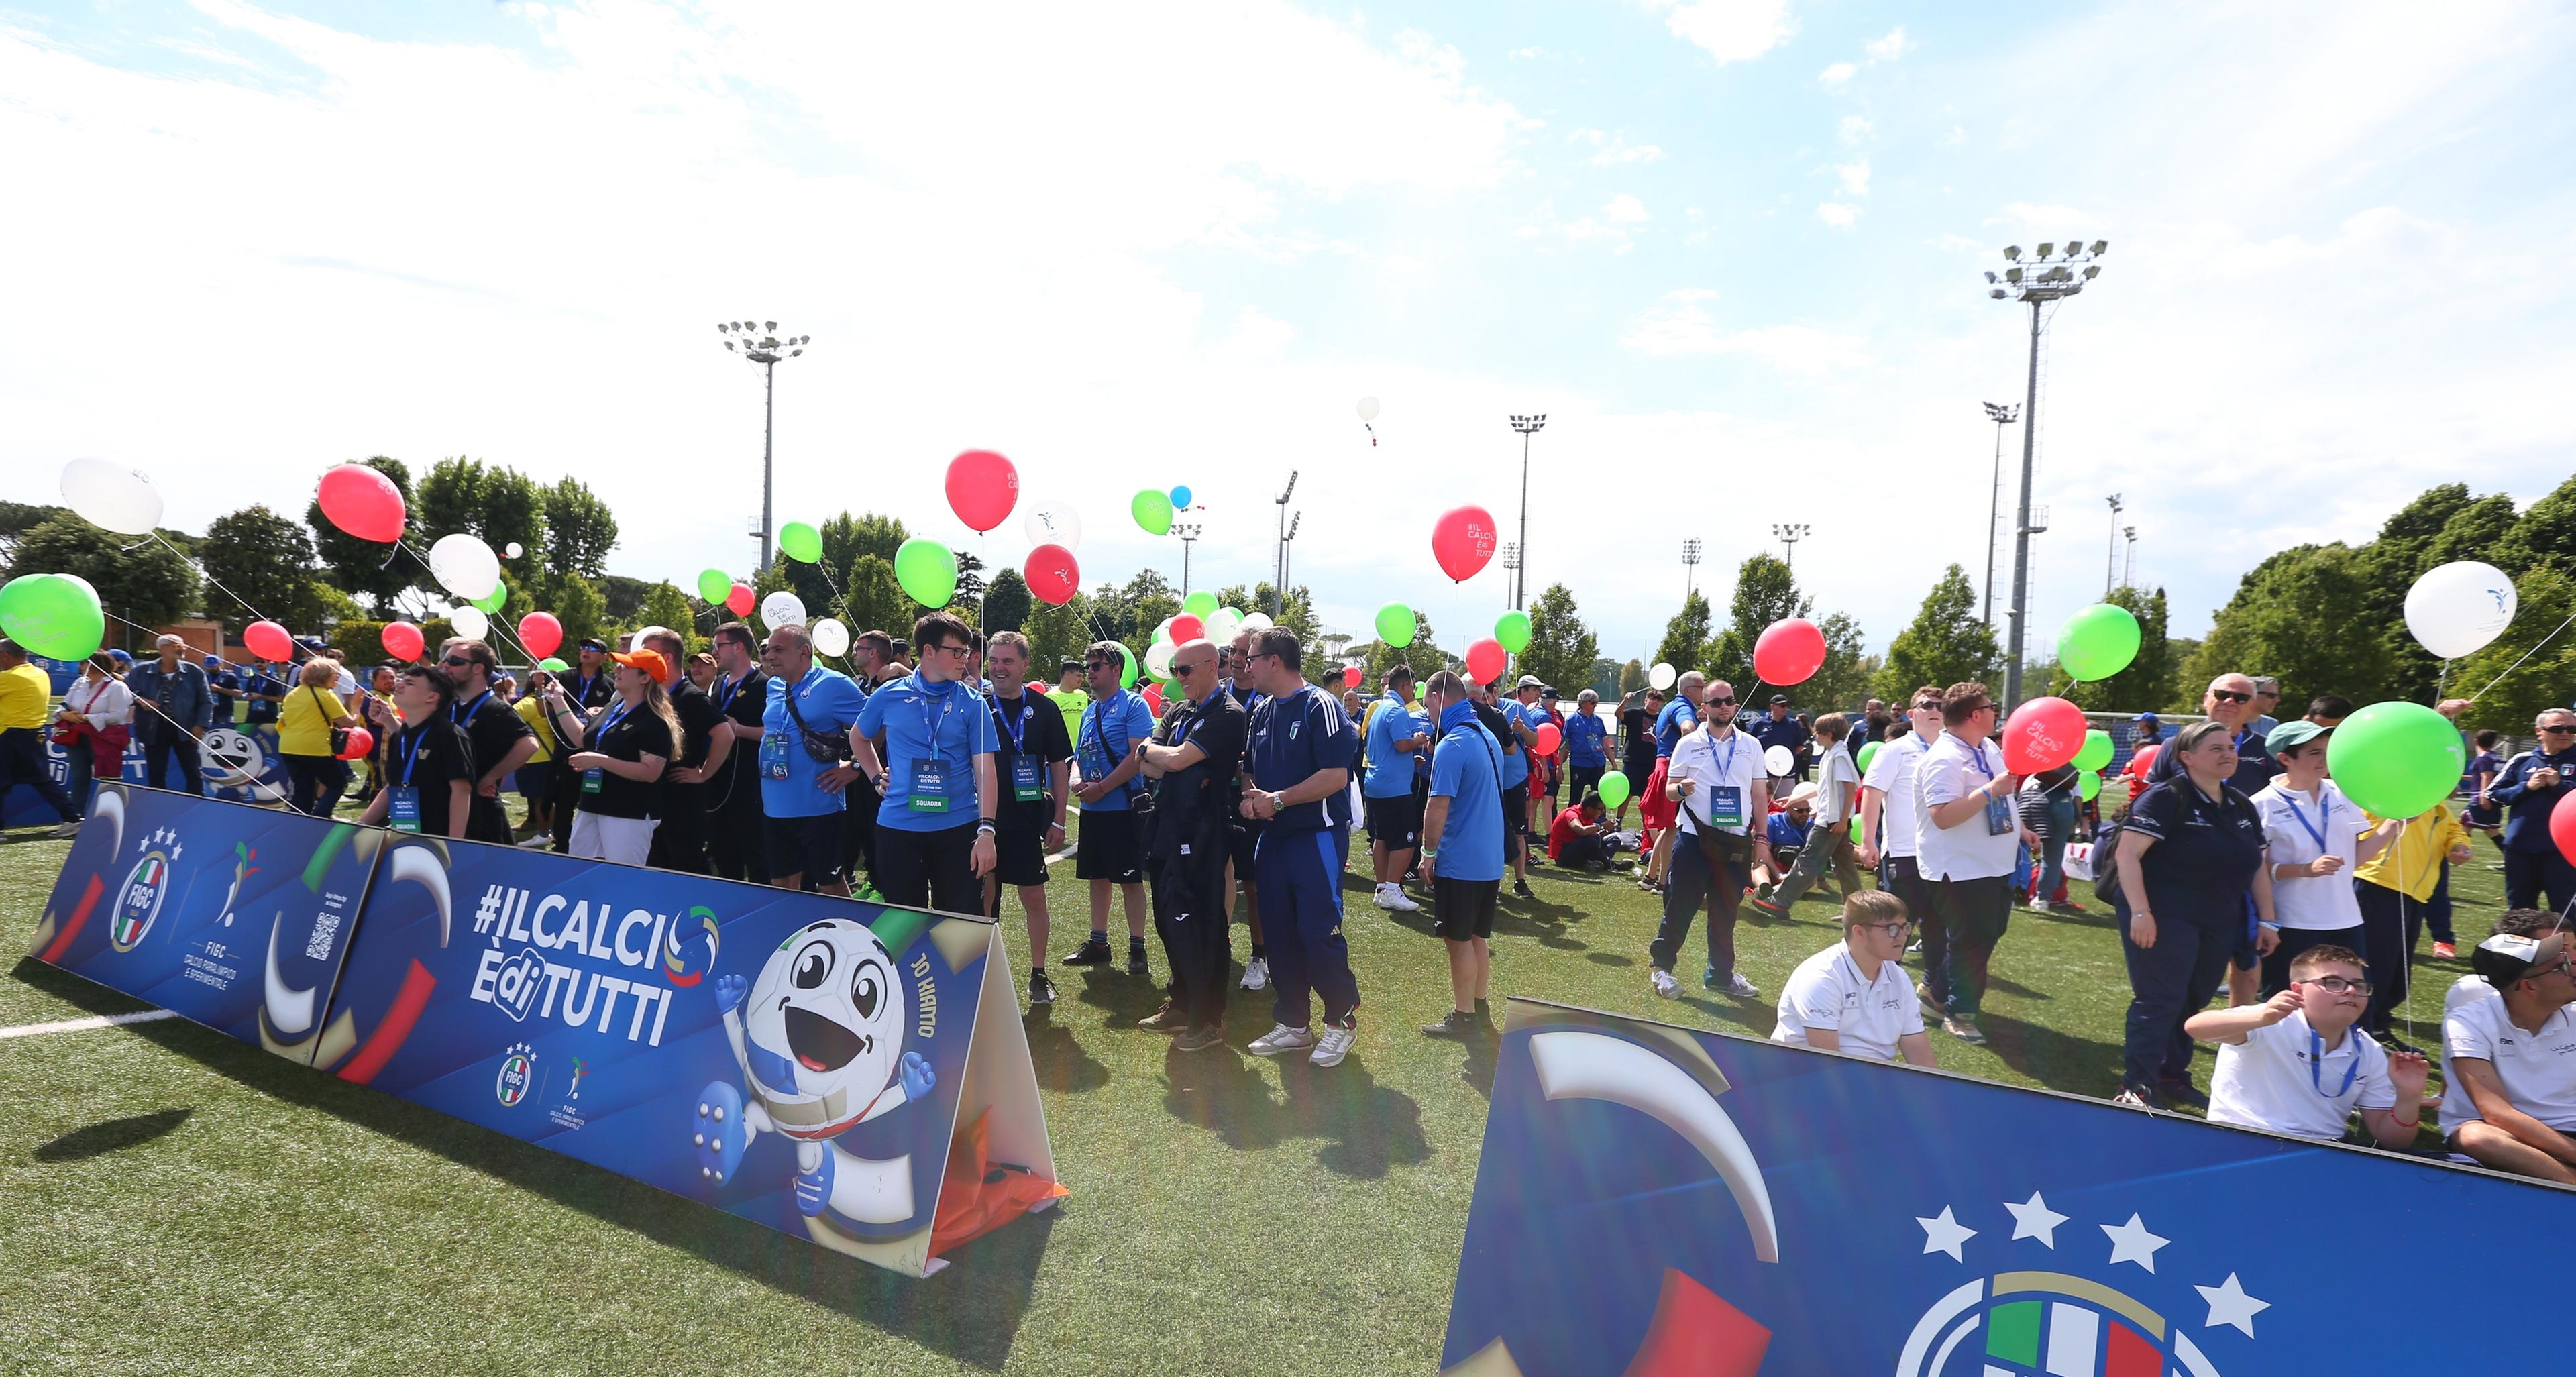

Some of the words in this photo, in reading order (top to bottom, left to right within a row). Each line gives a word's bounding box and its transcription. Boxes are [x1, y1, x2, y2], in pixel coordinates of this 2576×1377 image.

[1468, 523, 1481, 531] #IL
[780, 614, 796, 624] TUTTI
[2032, 720, 2045, 733] #IL
[2025, 747, 2051, 764] TUTTI
[127, 883, 154, 910] FIGC
[205, 941, 227, 958] FIGC
[184, 967, 191, 977] E
[917, 976, 937, 1038] KIAMO
[505, 1070, 523, 1086] FIGC
[562, 1105, 576, 1115] FIGC
